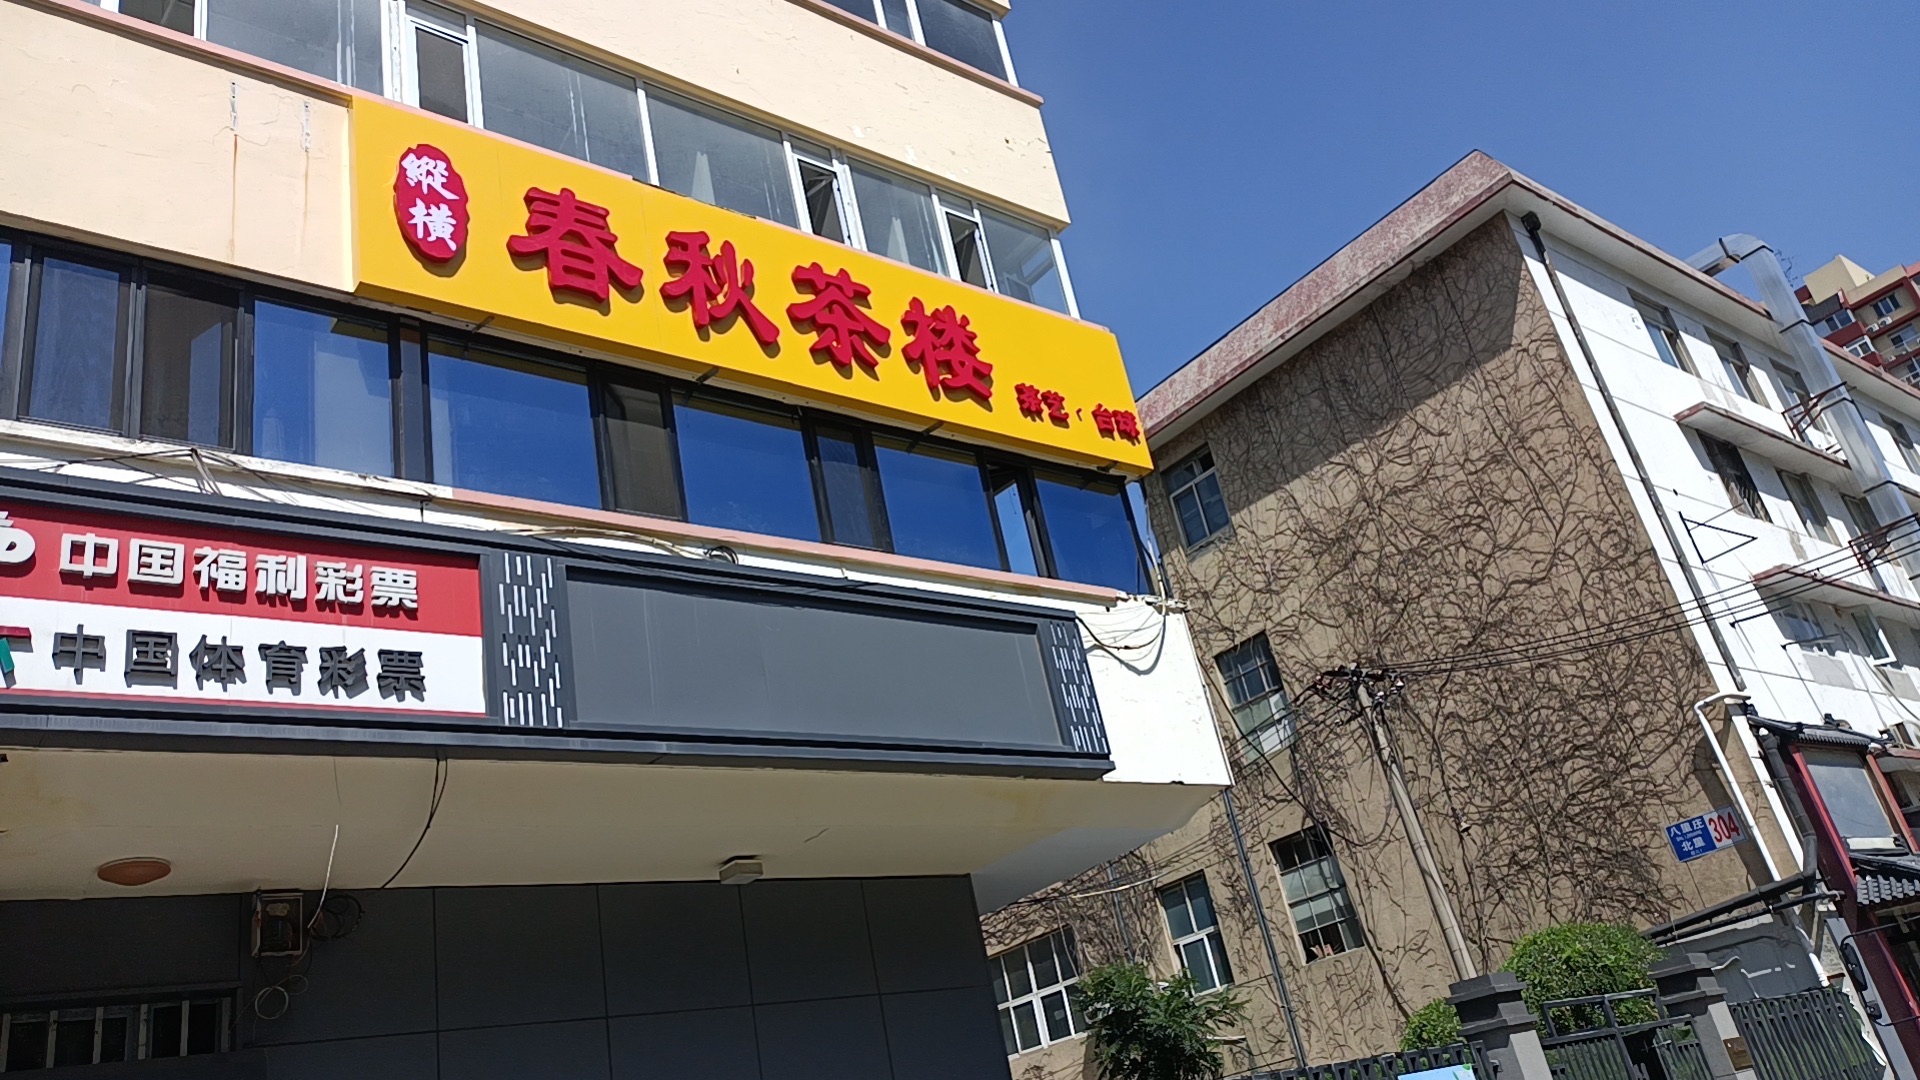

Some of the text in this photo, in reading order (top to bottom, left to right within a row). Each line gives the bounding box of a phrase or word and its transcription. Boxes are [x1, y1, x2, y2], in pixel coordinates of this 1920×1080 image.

[506, 187, 993, 400] 春秋茶楼
[59, 532, 418, 609] 中国福利彩票
[52, 623, 426, 702] 中国体育彩票
[1708, 811, 1740, 843] 304
